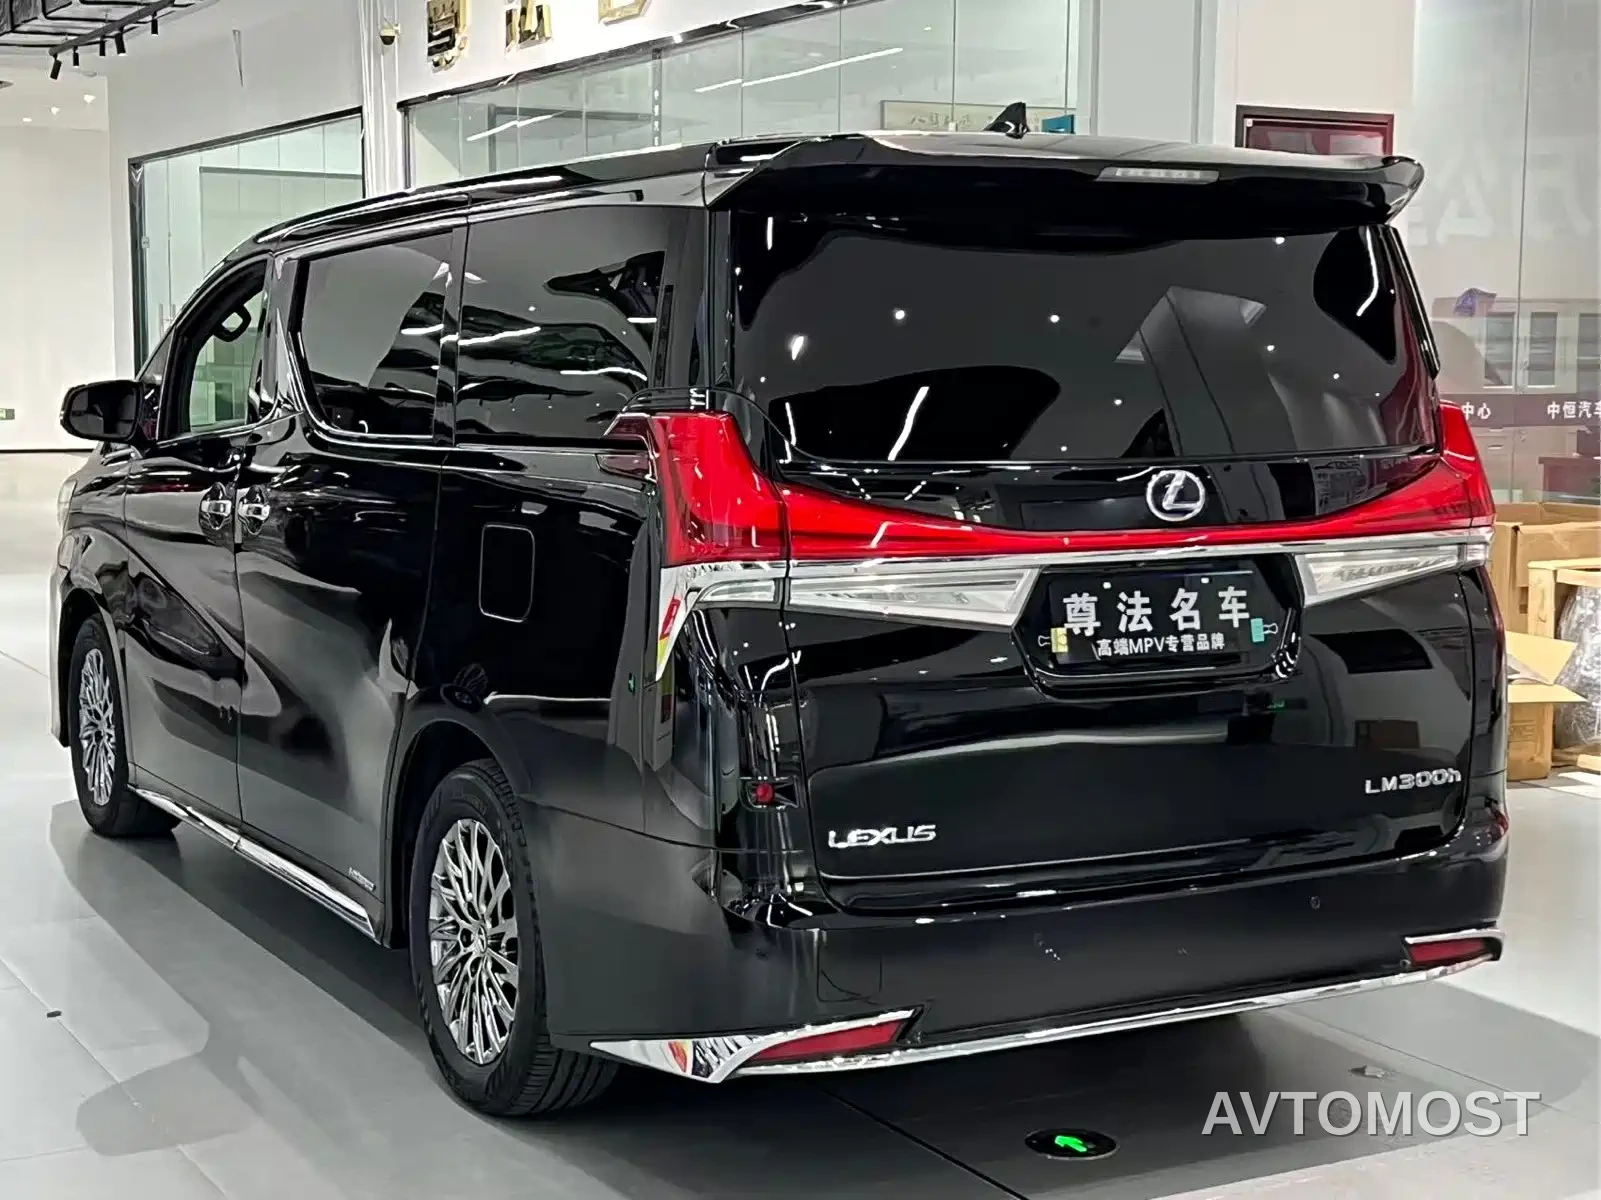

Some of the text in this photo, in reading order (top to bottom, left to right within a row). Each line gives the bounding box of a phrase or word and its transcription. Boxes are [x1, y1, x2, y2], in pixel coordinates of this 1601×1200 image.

[1461, 401, 1492, 420] 中心
[1063, 586, 1250, 637] 尊法名车
[1096, 632, 1225, 657] 高端MPV专营品牌
[1365, 767, 1462, 794] LM300h
[828, 824, 937, 848] LEXUS
